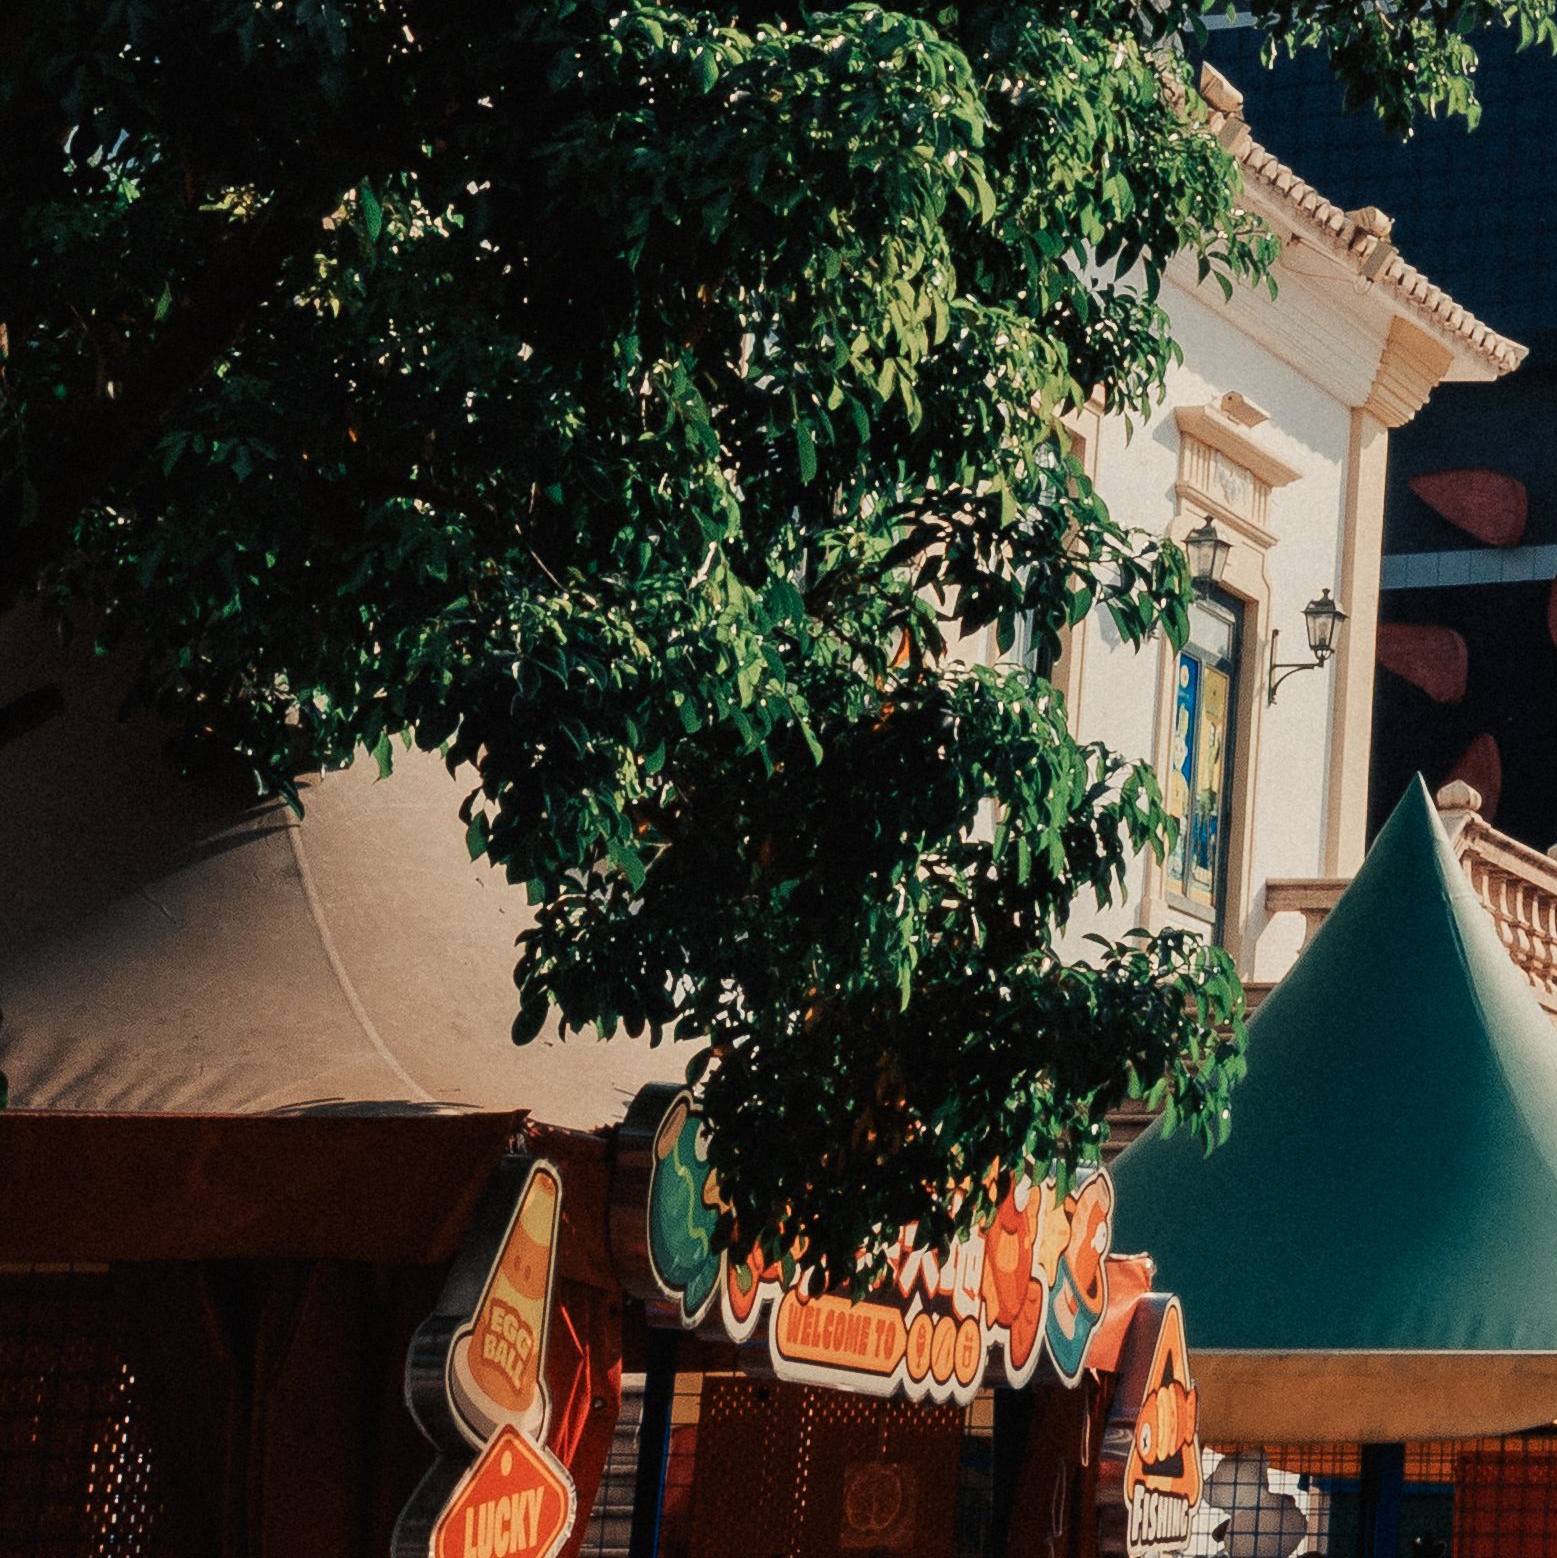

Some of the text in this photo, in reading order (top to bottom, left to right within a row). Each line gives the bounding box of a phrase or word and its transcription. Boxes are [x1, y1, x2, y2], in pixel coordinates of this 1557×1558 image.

[490, 1305, 534, 1362] EGG
[786, 1302, 897, 1360] WELCOME TO
[482, 1333, 525, 1390] BALL
[1131, 1483, 1190, 1543] FISHING
